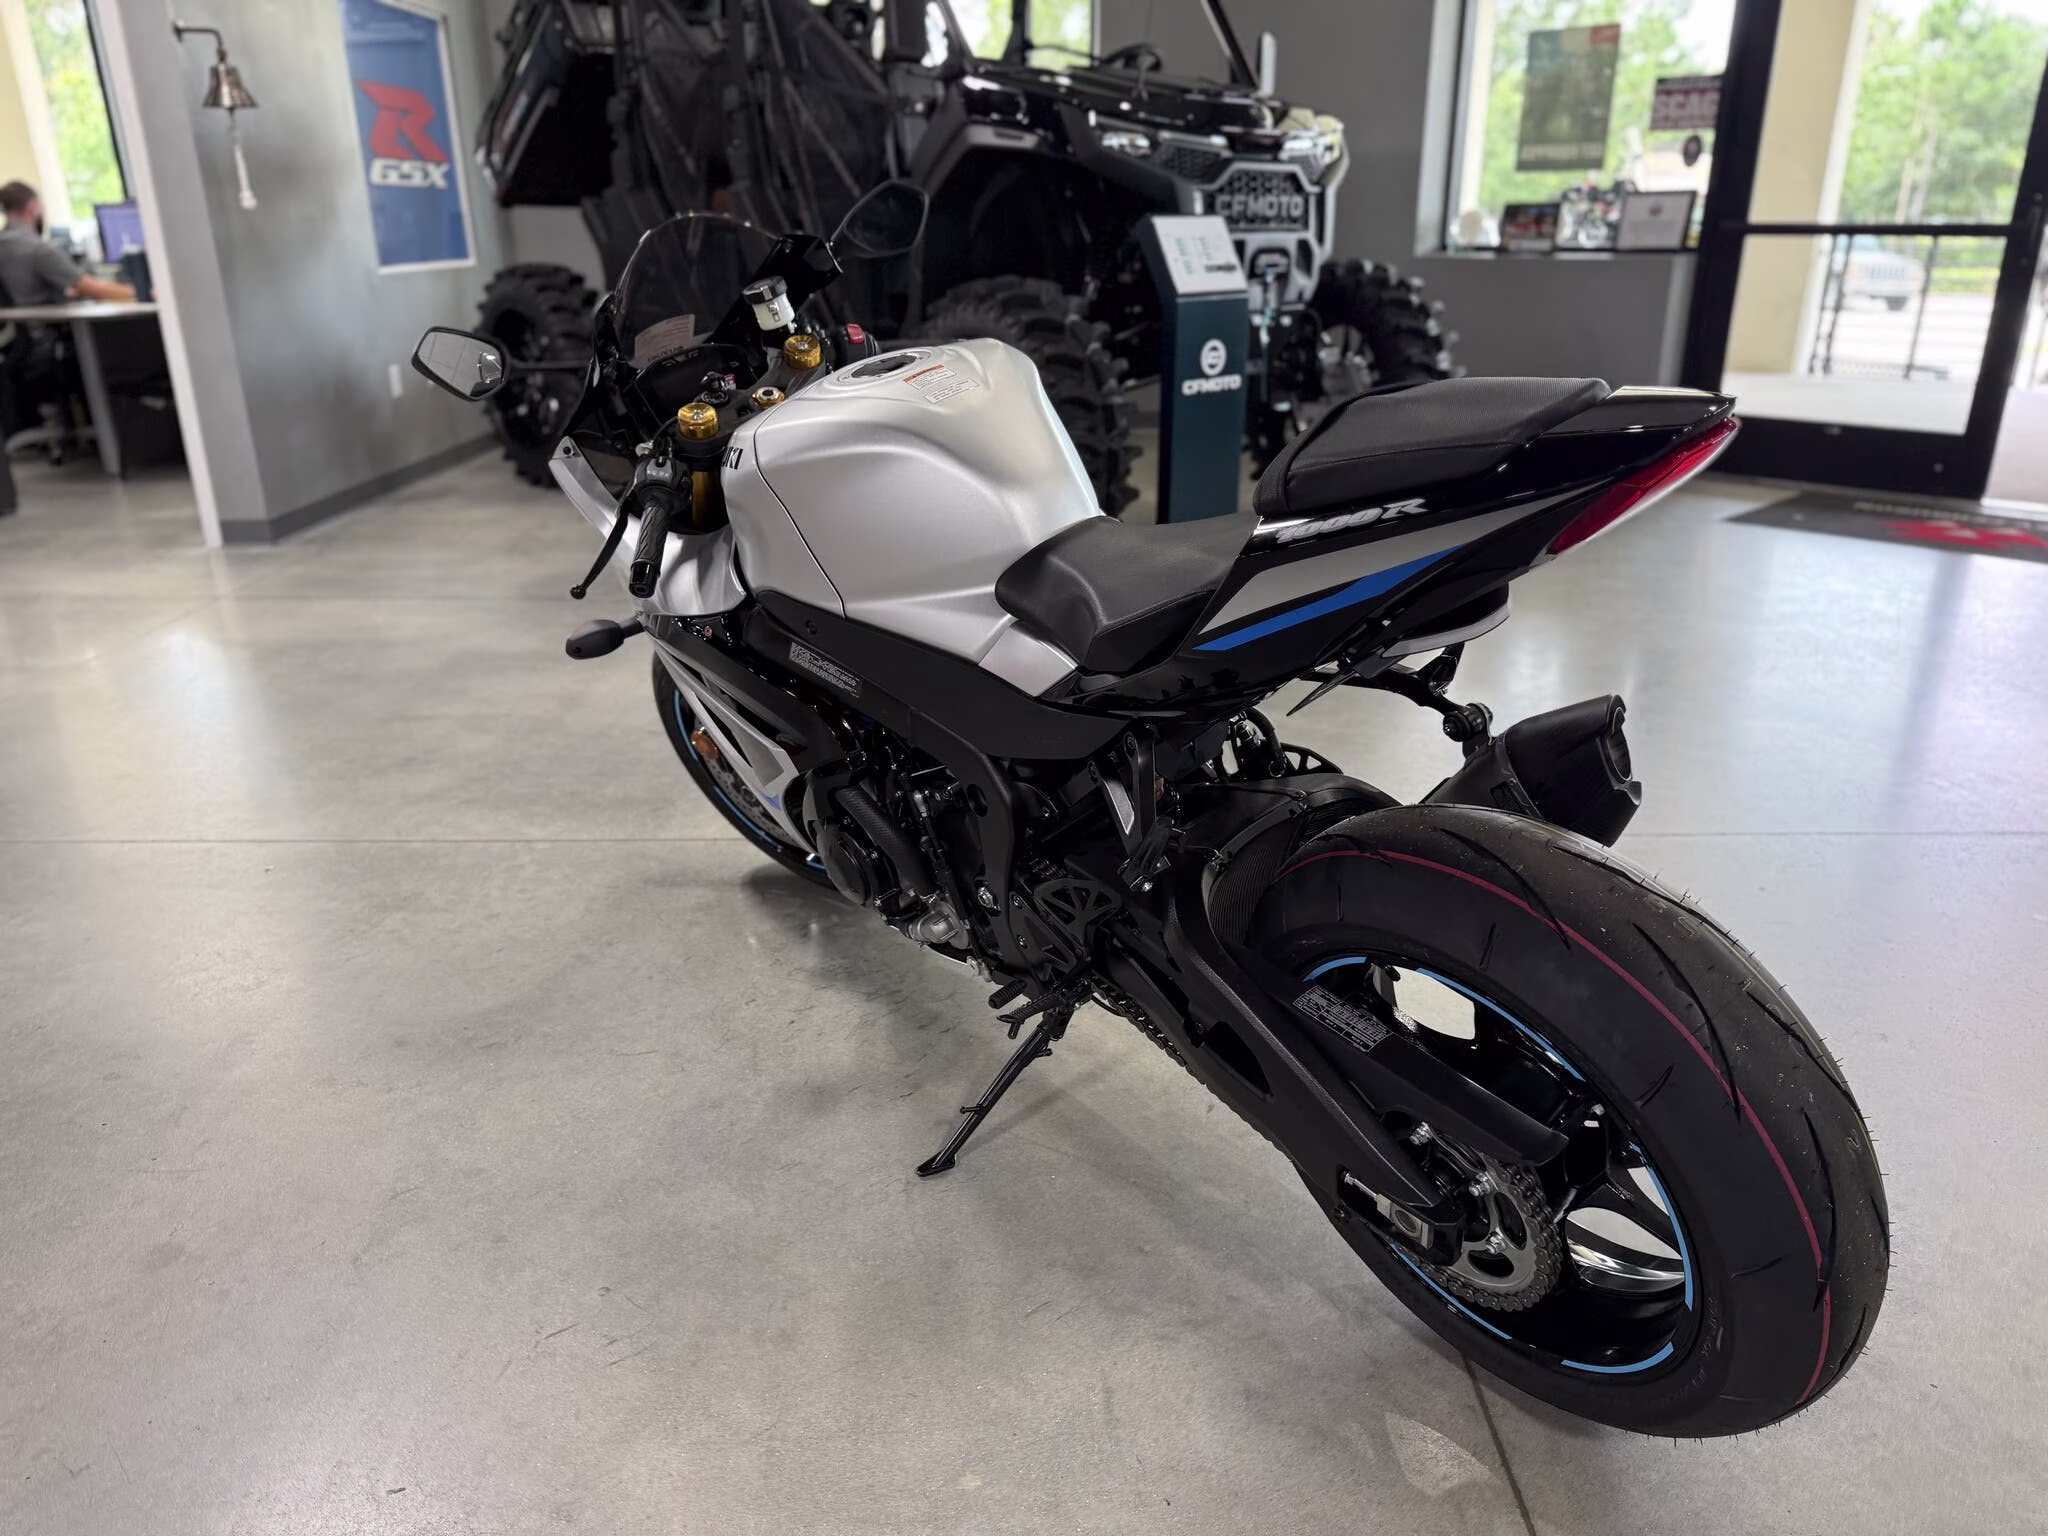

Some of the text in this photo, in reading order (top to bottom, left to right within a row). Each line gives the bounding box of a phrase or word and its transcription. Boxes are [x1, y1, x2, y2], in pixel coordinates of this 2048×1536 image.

[369, 157, 448, 189] GSX
[1215, 193, 1303, 217] CFMOTO
[1182, 374, 1241, 395] CFMOTO
